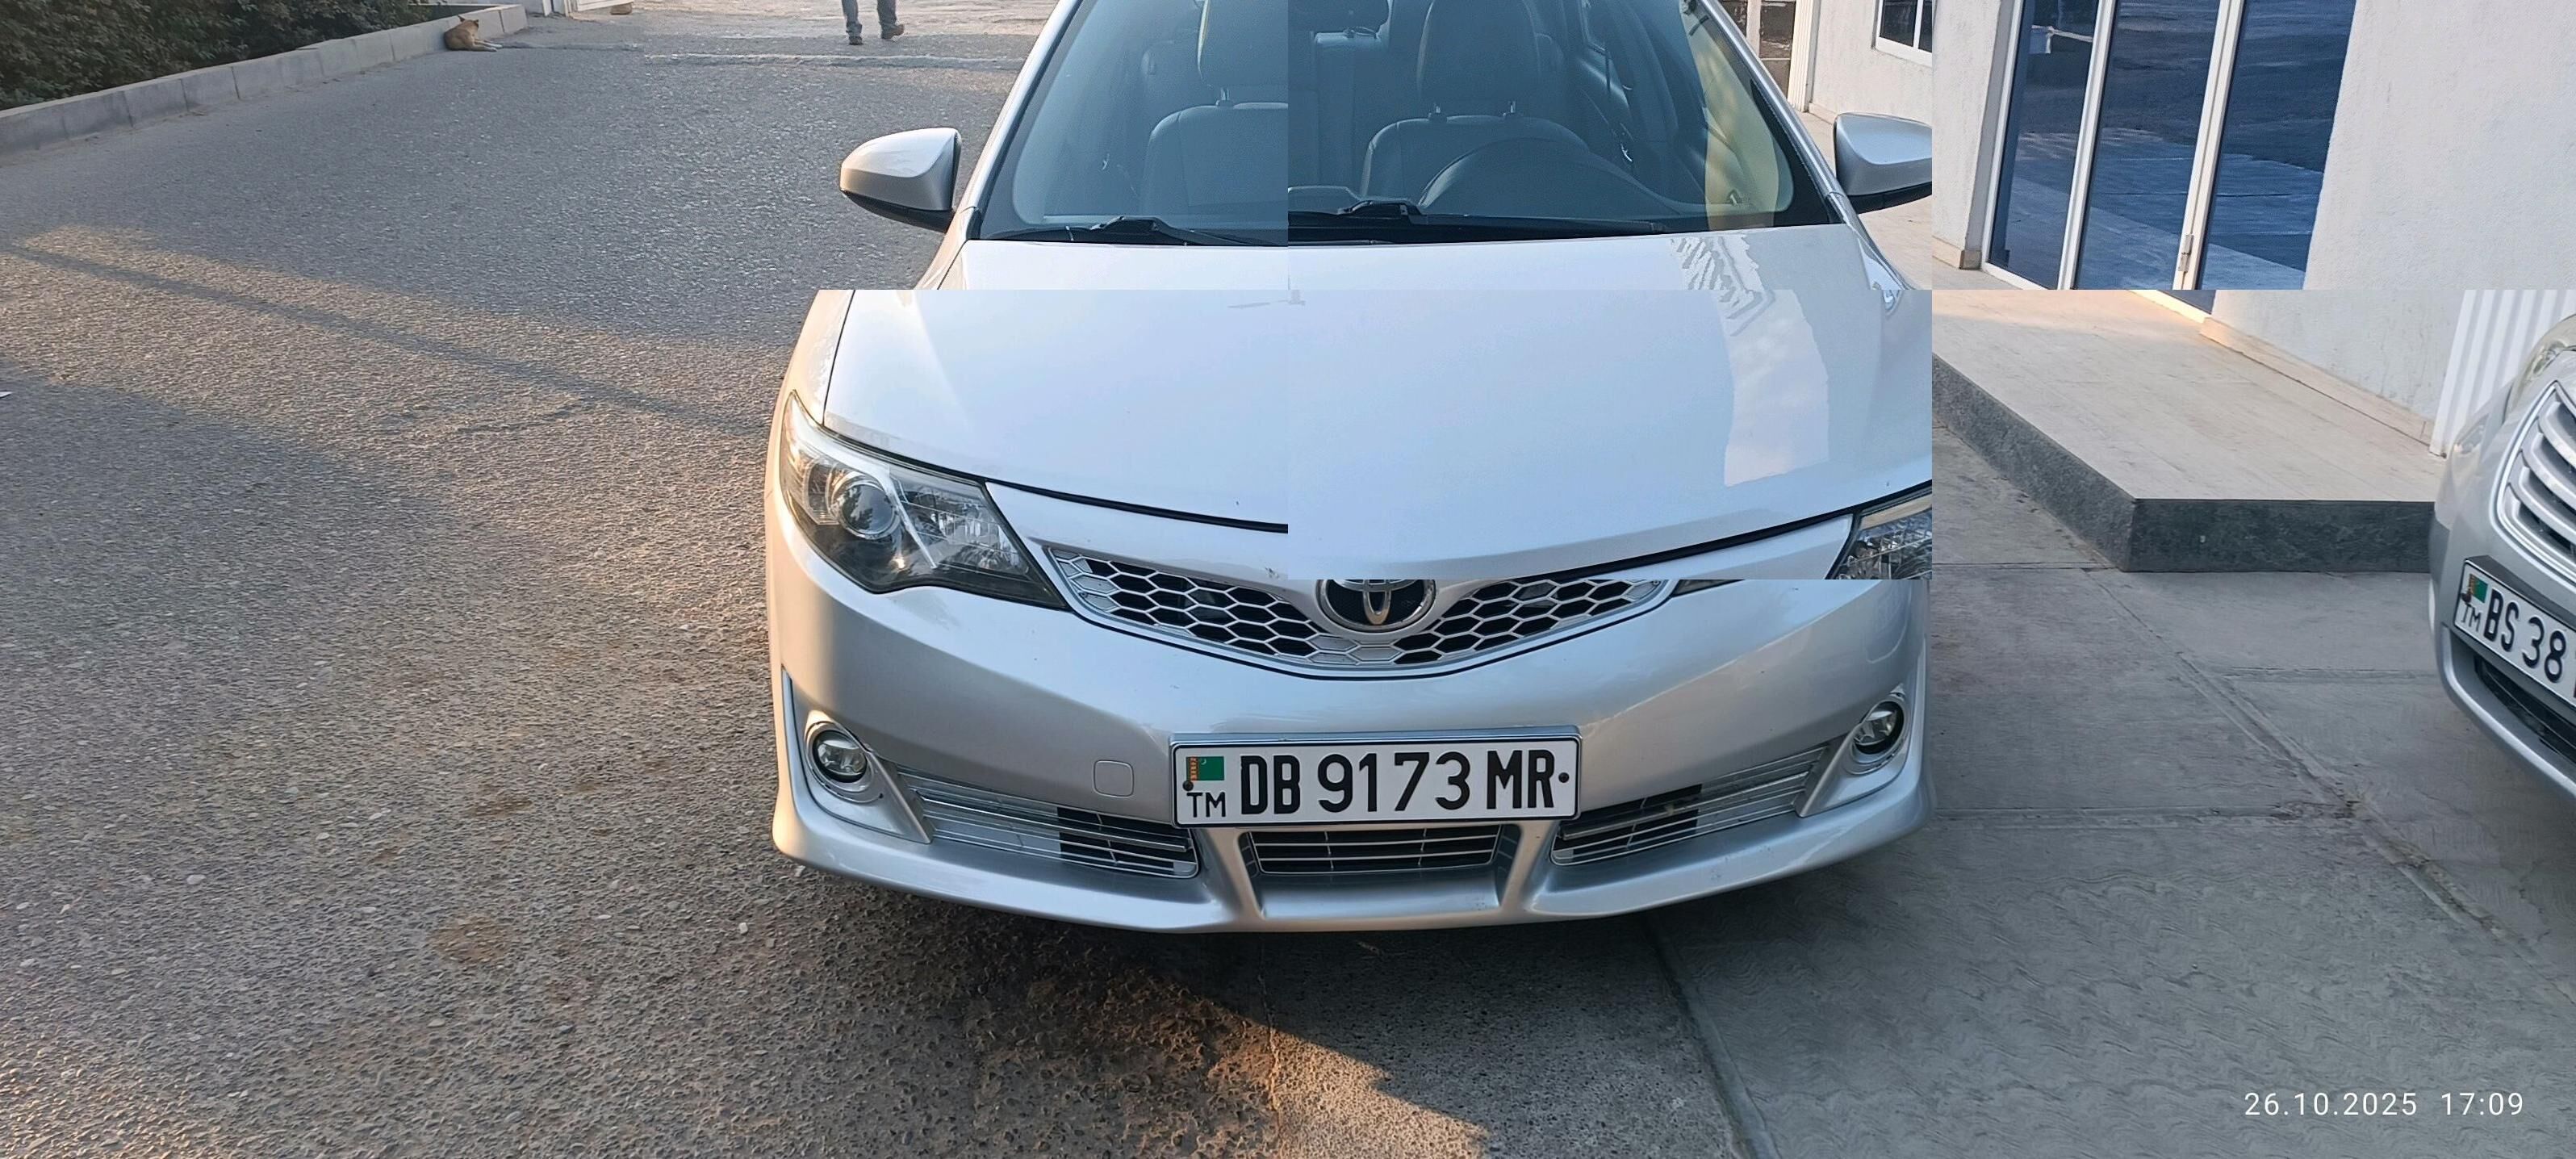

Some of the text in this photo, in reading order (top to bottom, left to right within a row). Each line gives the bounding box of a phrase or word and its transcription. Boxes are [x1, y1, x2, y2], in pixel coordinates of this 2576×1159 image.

[2461, 603, 2481, 633] TM
[2484, 588, 2576, 699] BS 38
[1187, 792, 1226, 818] TM
[1240, 749, 1555, 815] DB 9173 MR
